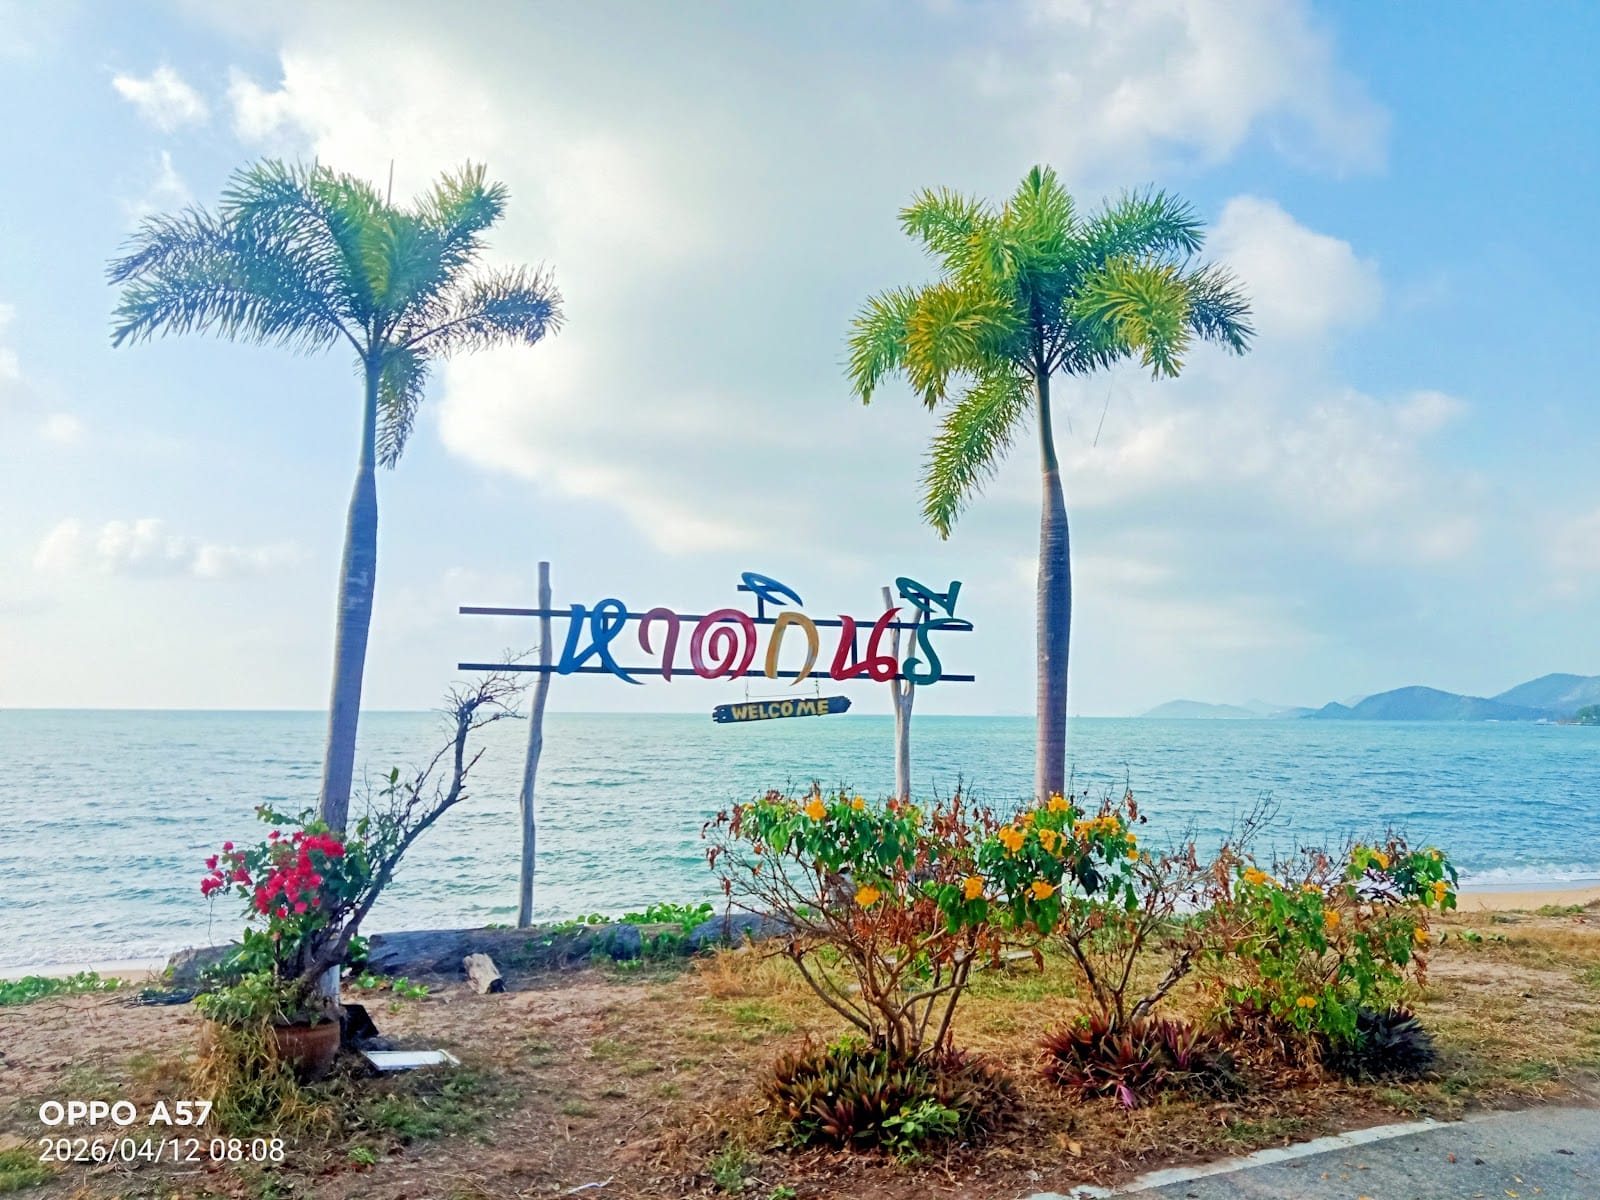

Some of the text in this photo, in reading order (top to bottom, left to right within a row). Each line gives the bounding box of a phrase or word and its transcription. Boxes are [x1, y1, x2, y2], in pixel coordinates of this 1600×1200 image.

[558, 571, 973, 686] หาดกินรี
[731, 700, 829, 720] WELCOME
